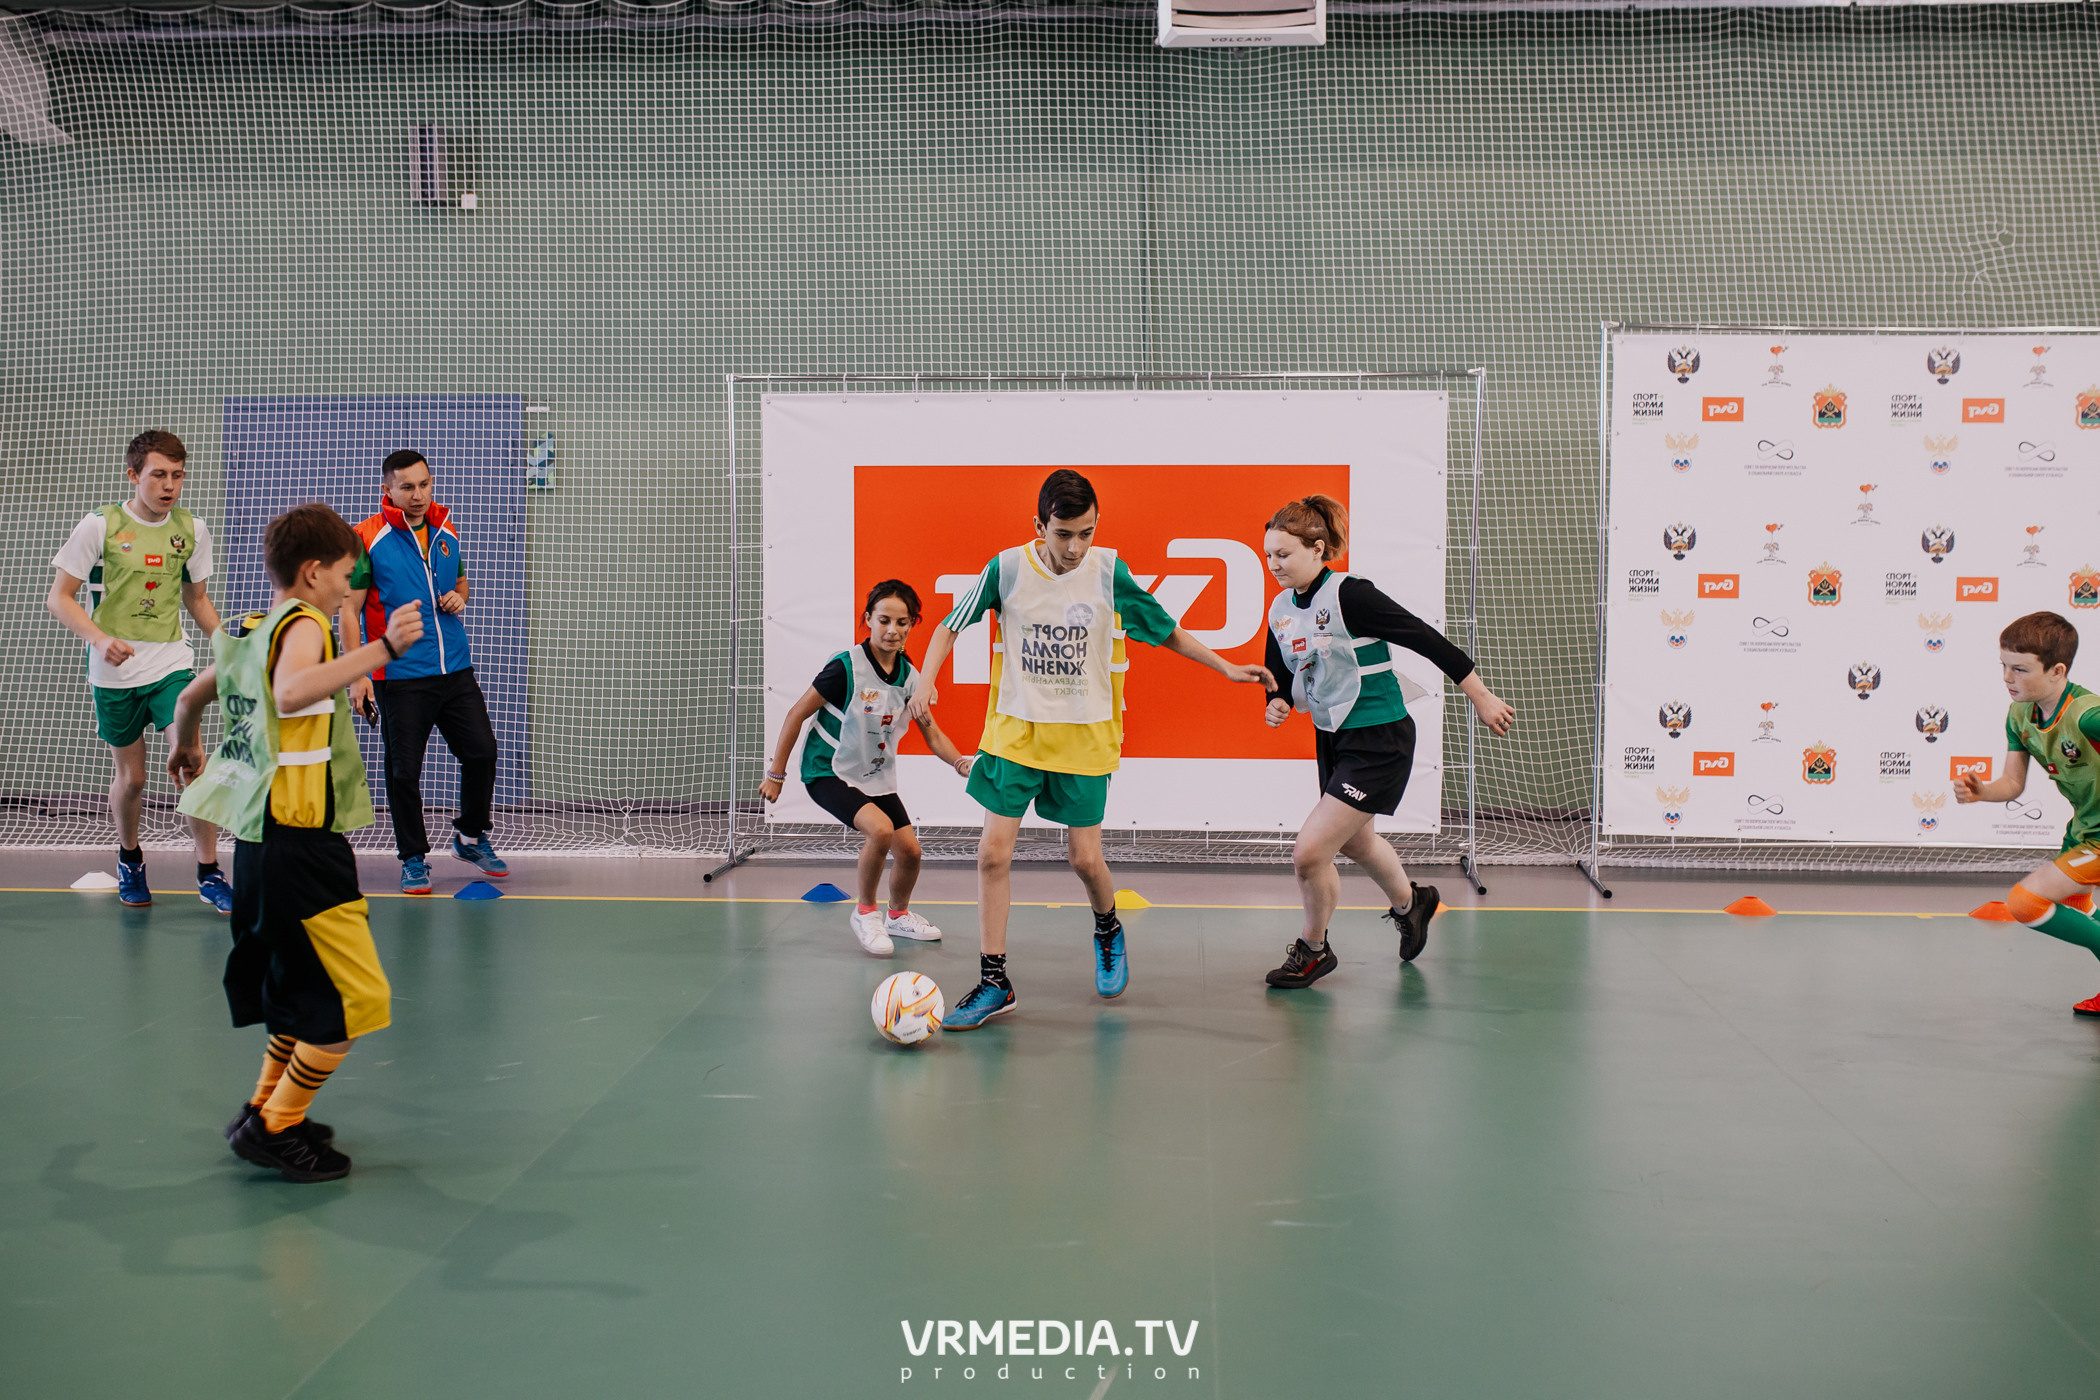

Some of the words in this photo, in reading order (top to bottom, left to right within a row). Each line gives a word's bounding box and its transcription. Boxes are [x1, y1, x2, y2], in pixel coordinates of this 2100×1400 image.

[1629, 569, 1654, 577] СПОРТ
[1628, 577, 1659, 585] НОРМА
[1628, 585, 1659, 593] ЖИЗНИ
[1341, 782, 1367, 802] RAY
